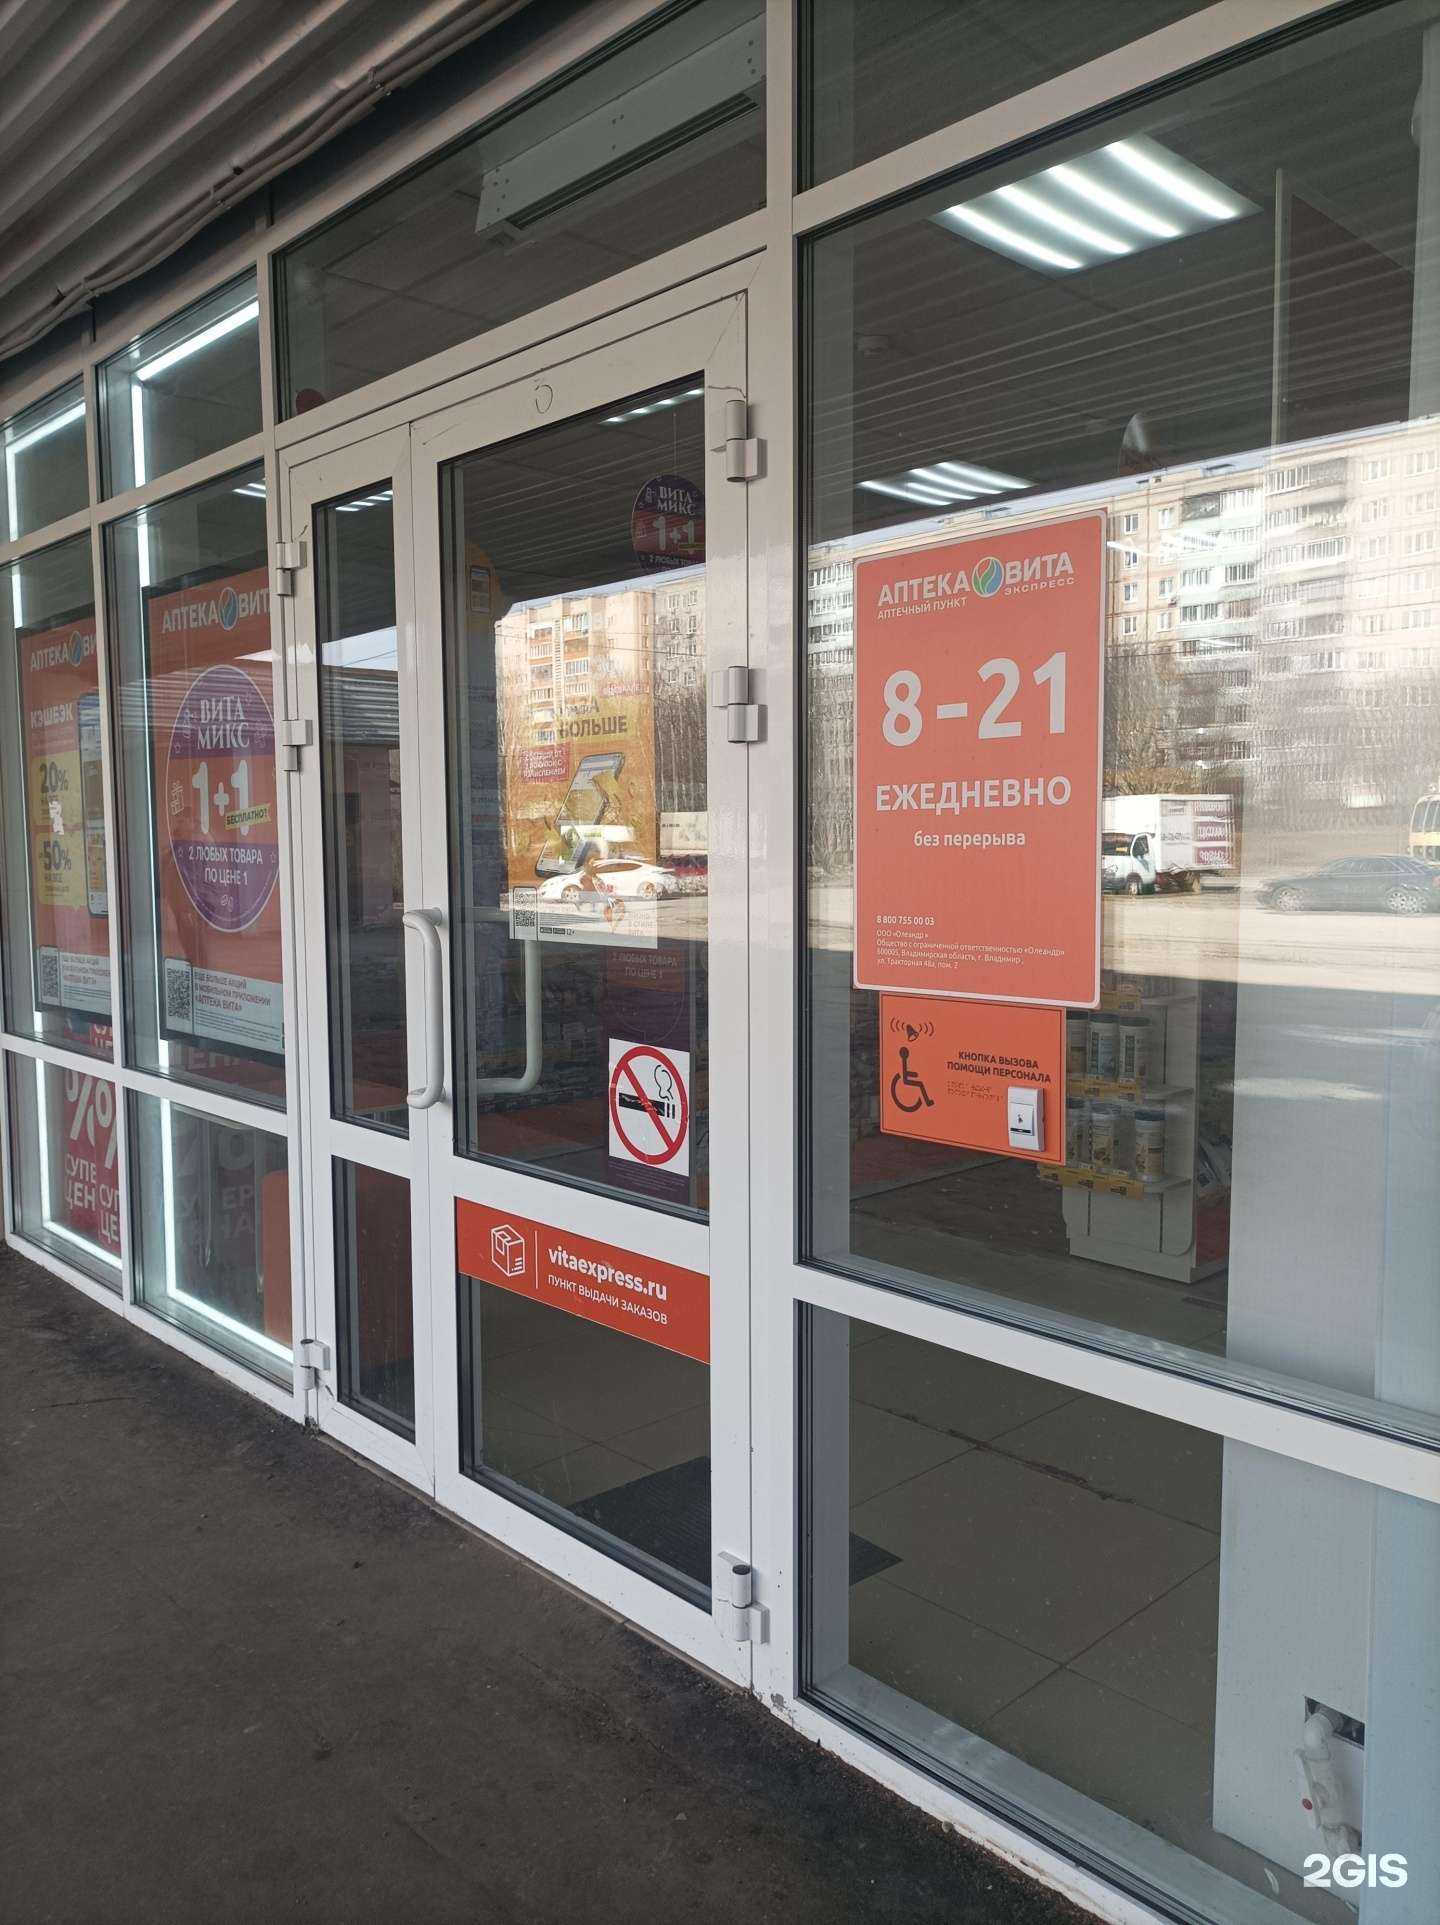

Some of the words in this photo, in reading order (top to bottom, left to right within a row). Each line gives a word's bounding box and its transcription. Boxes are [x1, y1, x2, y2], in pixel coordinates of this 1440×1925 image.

[656, 499, 698, 516] МИКС
[877, 570, 970, 607] АПТЕКА
[1004, 551, 1075, 585] ВИТА
[1003, 576, 1076, 597] ЭКСПРЕСС
[162, 601, 219, 634] АПТЕКА
[238, 588, 270, 618] ВИТ
[877, 599, 932, 620] АПТЕЧНЫЙ
[932, 596, 967, 612] ПУНКТ
[29, 643, 69, 672] АПТЕКА
[83, 634, 98, 658] ВИ
[200, 695, 245, 724] ВИТА
[197, 721, 250, 750] МИКС
[876, 775, 1072, 815] ЕЖЕДНЕВНО
[913, 830, 940, 847] без
[943, 832, 1027, 850] перерыва
[195, 846, 228, 863] ЛЮБЫХ
[229, 847, 264, 865] ТОВАРА
[204, 867, 217, 882] ПО
[219, 869, 241, 886] ЦЕНЕ
[882, 915, 897, 925] 800
[898, 916, 912, 925] 755
[913, 916, 923, 926] 00
[924, 917, 935, 926] 03
[947, 1061, 991, 1076] ПОМОЩИ
[993, 1068, 1052, 1083] ПЕРСОНАЛА
[958, 1051, 997, 1064] КНОПКА
[998, 1056, 1039, 1070] ВЫЗОВА
[65, 1153, 97, 1184] СУПЕ
[65, 1178, 97, 1211] ЦЕН
[547, 1245, 668, 1301] vitaexpress.ru
[547, 1274, 577, 1292] ПУНКТ
[578, 1285, 619, 1307] ВЫДАЧИ
[621, 1299, 668, 1325] ЗАКАЗОВ
